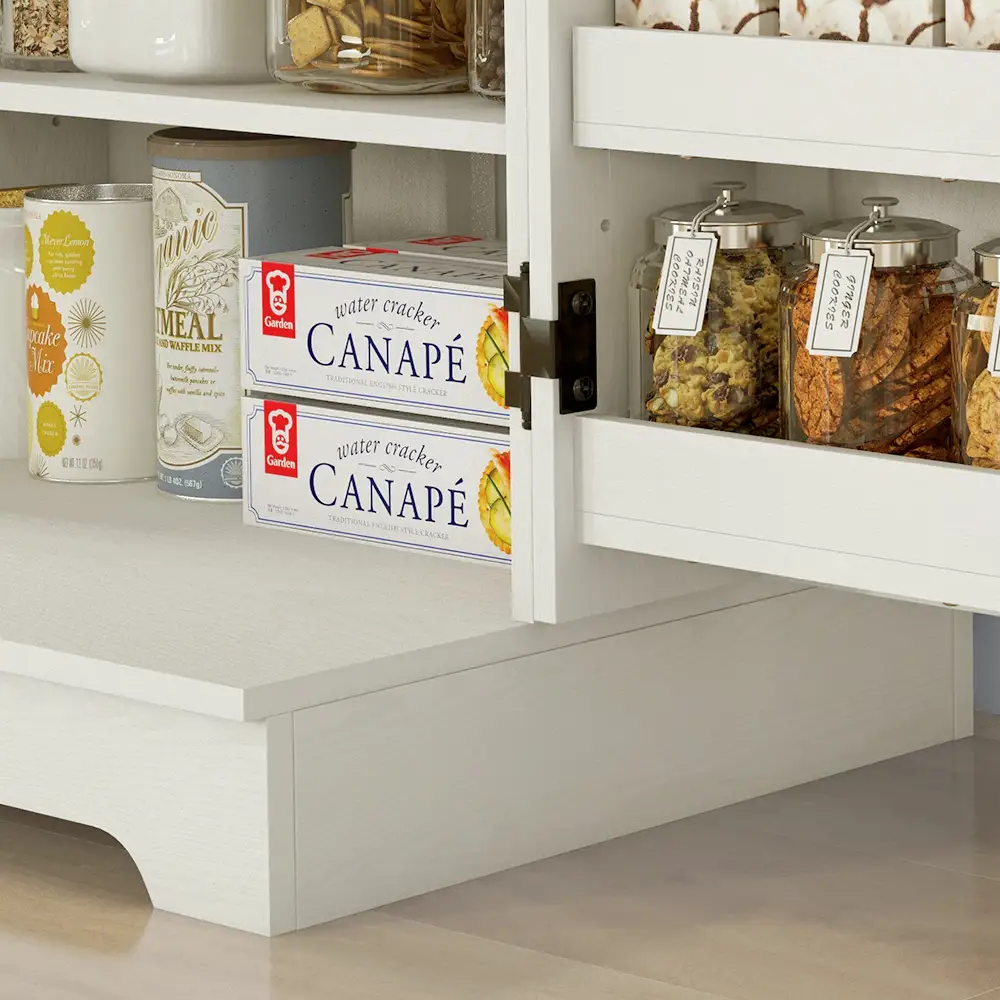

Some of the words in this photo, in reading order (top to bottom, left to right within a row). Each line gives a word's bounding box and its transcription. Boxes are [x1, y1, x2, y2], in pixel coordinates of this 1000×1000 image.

[62, 233, 90, 247] Lemon
[665, 254, 681, 311] COOKIES
[676, 250, 694, 314] OATMEAL
[688, 258, 704, 307] RAISIN
[334, 296, 379, 320] water
[383, 297, 441, 331] cracker
[825, 269, 842, 331] COOKIES
[840, 275, 856, 329] GINGER
[155, 306, 223, 341] TMEAL
[264, 315, 294, 331] Garden
[30, 346, 55, 374] Mix
[169, 340, 201, 352] WAFFLE
[202, 343, 223, 353] MIX
[306, 322, 467, 384] CANAPÉ
[325, 374, 367, 387] TRADITIONAL
[369, 380, 397, 390] ENGLISH
[398, 384, 417, 394] STYLE
[418, 387, 448, 397] CRACKER
[267, 454, 296, 470] Garden
[336, 437, 380, 460] water
[385, 440, 443, 474] cracker
[184, 479, 203, 490] (567g)
[309, 462, 469, 528] CANAPÉ
[328, 514, 370, 528] TRADITIONAL
[371, 521, 399, 532] ENGLISH
[400, 525, 420, 536] STYLE
[420, 529, 449, 540] CRACKER
